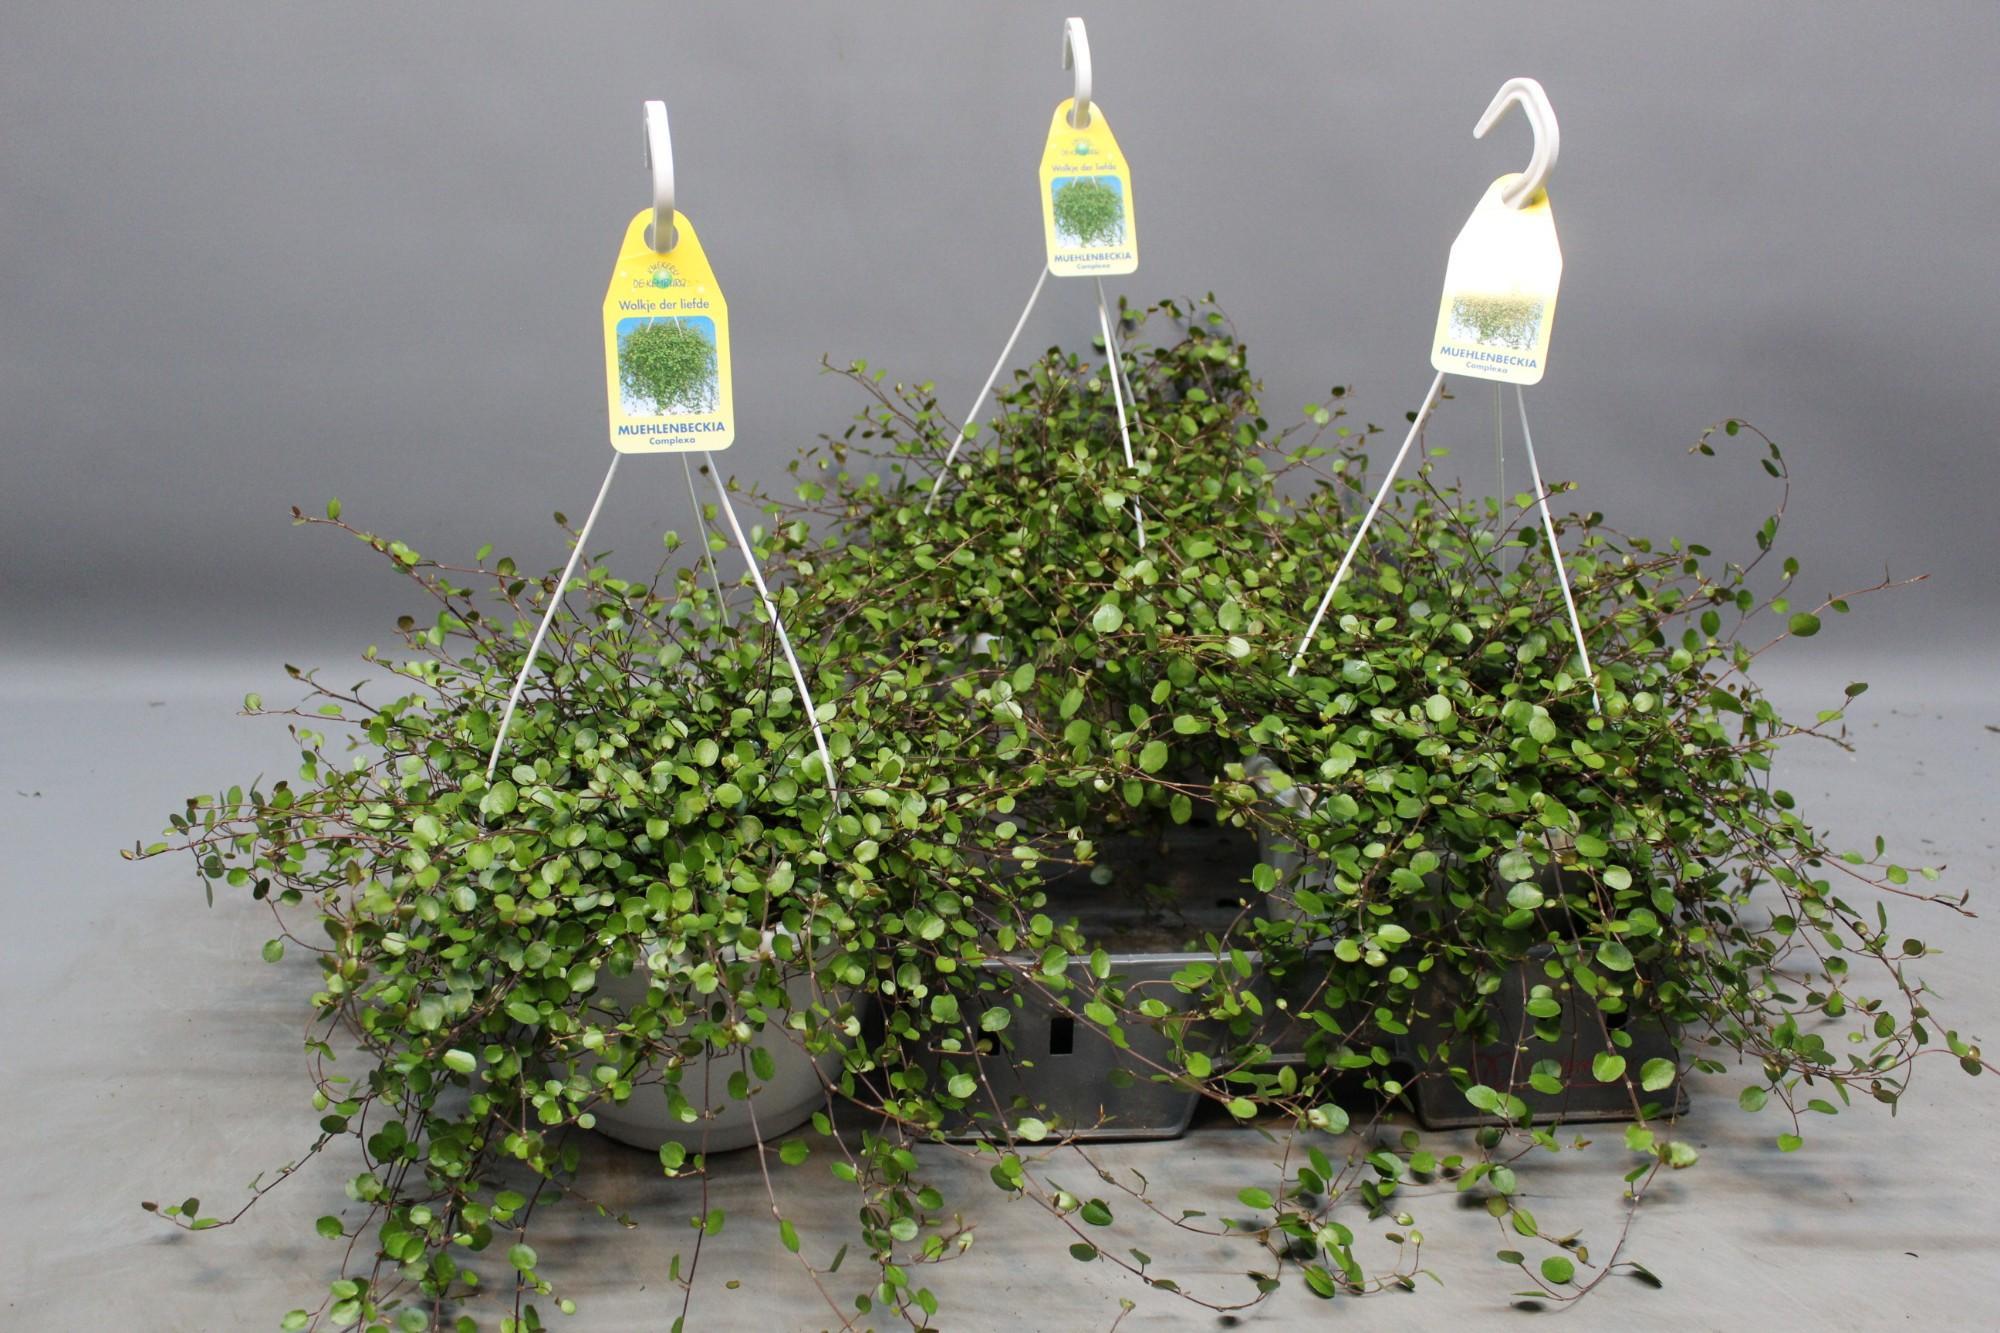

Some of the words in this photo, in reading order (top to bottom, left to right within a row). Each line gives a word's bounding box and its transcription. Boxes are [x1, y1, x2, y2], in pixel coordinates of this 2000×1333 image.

[1054, 251, 1132, 263] MUEHLENBECKIA
[618, 299, 656, 312] Wolkje
[659, 299, 677, 310] der
[680, 298, 710, 309] liefde
[1439, 346, 1538, 369] MUEHLENBECKIA
[1465, 361, 1509, 374] Complexa
[617, 421, 726, 436] MUEHLENBECKIA
[649, 436, 696, 447] Complexa
